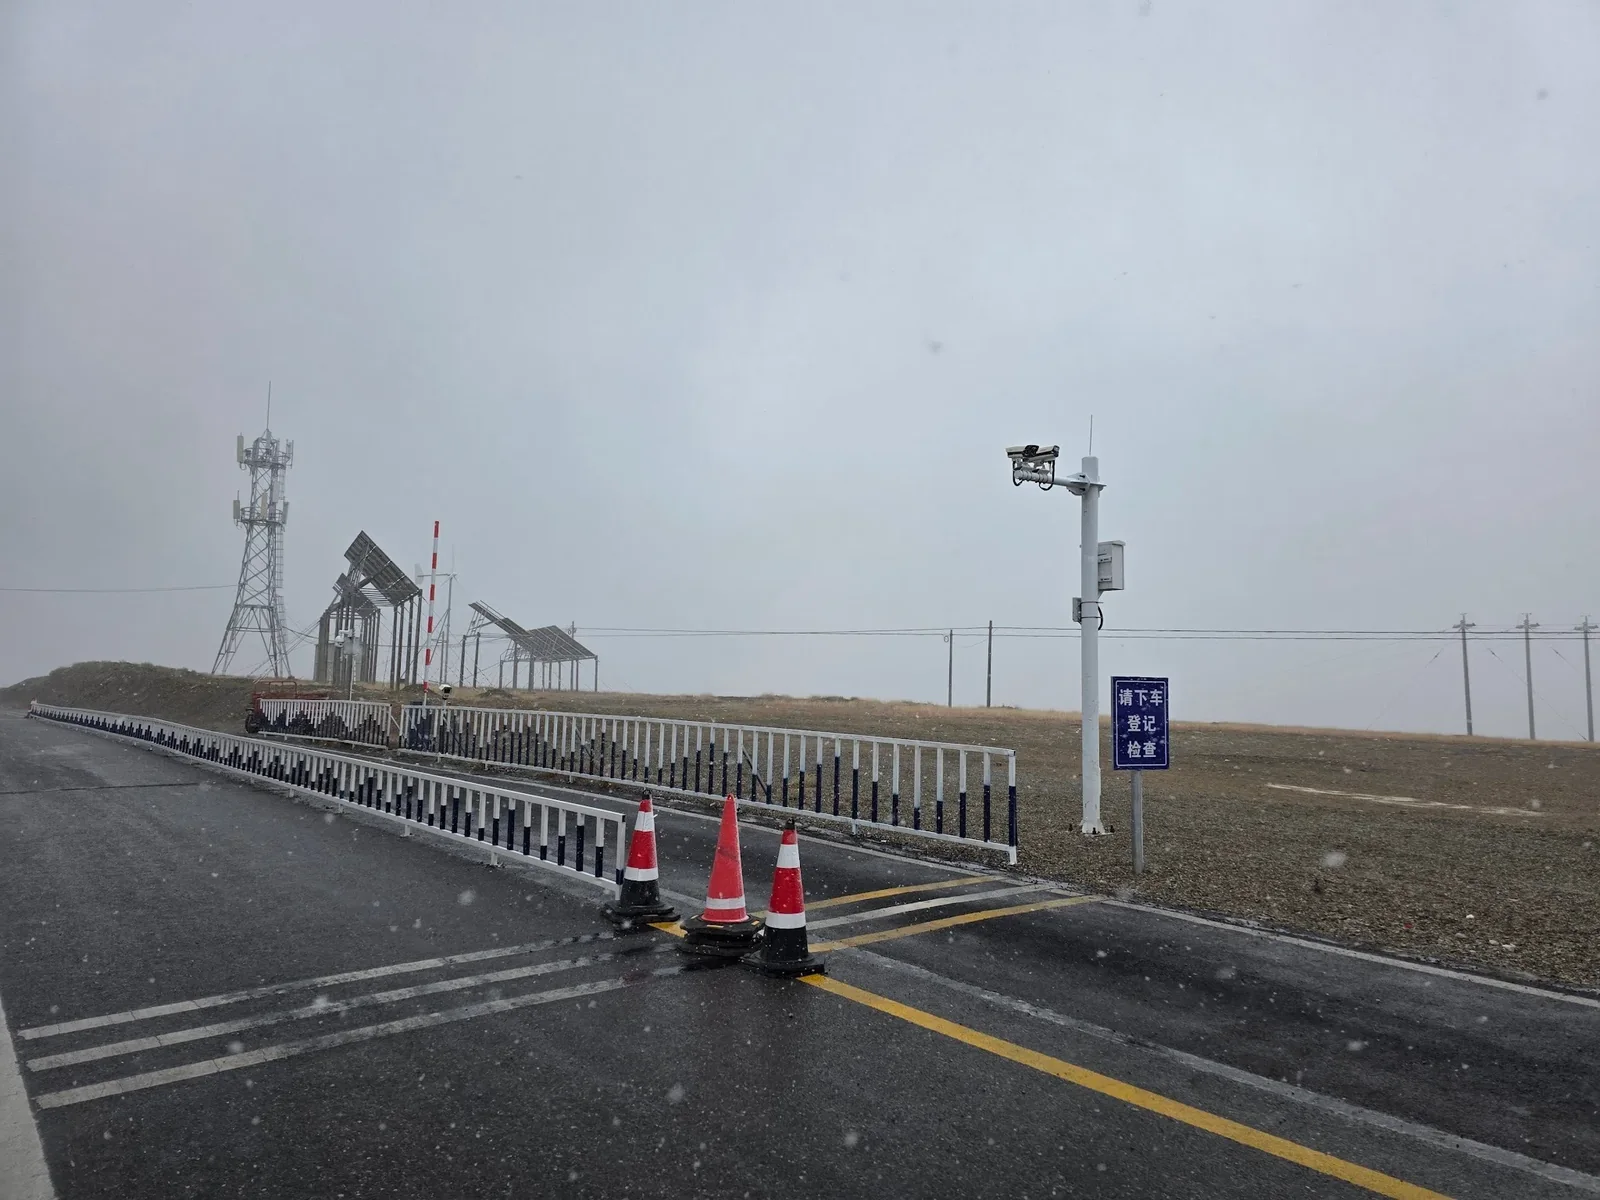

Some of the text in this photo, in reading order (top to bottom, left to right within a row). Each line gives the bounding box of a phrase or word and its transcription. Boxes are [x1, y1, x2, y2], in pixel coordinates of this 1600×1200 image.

[1119, 688, 1163, 706] 请下车
[1127, 715, 1156, 732] 登记
[1127, 740, 1157, 758] 检查
